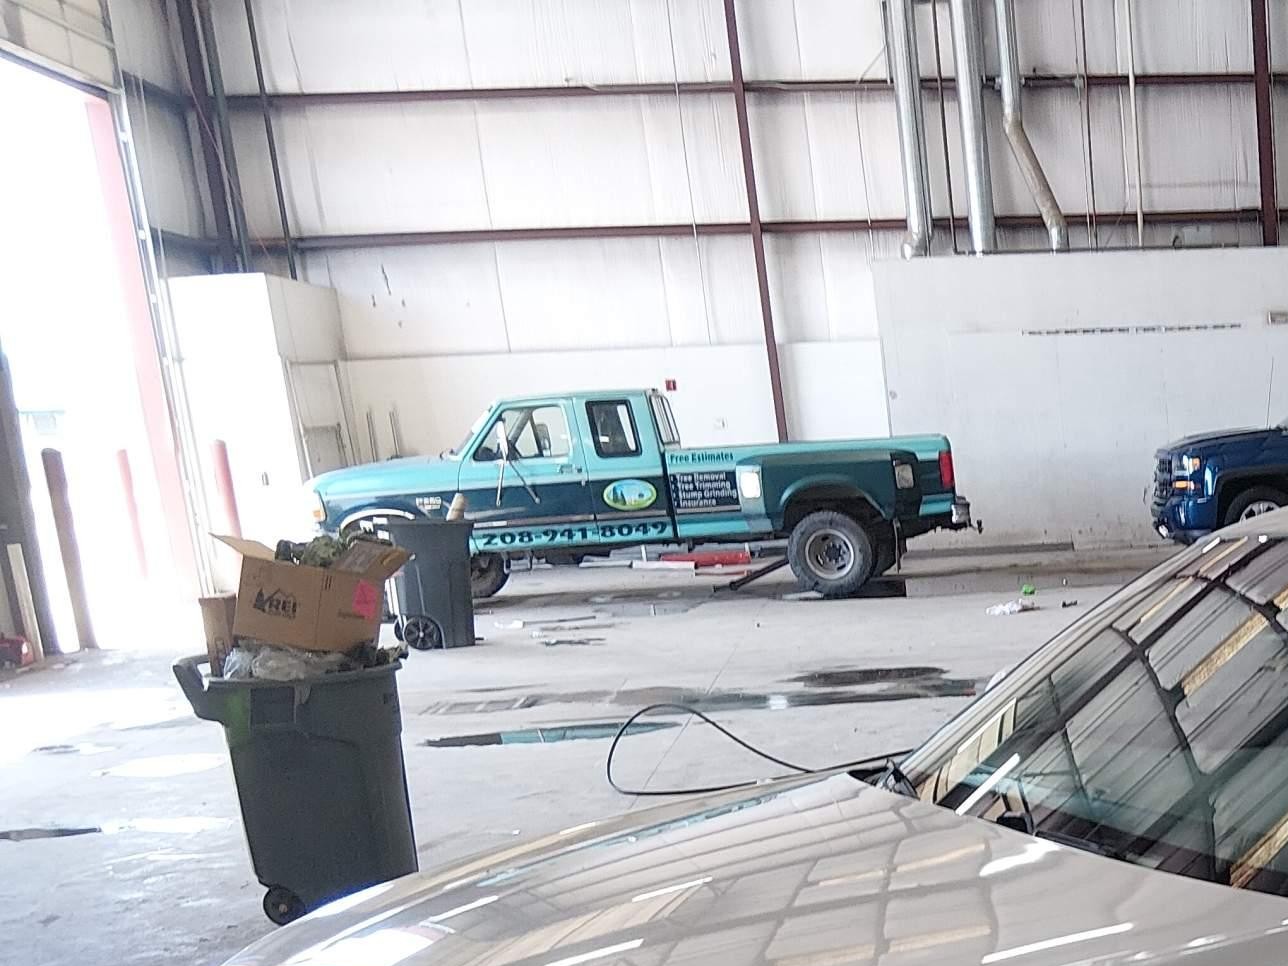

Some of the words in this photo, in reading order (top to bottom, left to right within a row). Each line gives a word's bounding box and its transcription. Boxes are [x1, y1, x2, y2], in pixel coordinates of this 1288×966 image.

[670, 454, 689, 463] Free
[692, 451, 734, 463] Estimates
[694, 471, 726, 481] Removal
[694, 480, 731, 490] Trimming
[704, 488, 737, 499] Grinding
[680, 499, 717, 508] Insurance
[482, 522, 667, 546] 208-941-8049
[268, 599, 297, 614] REI
